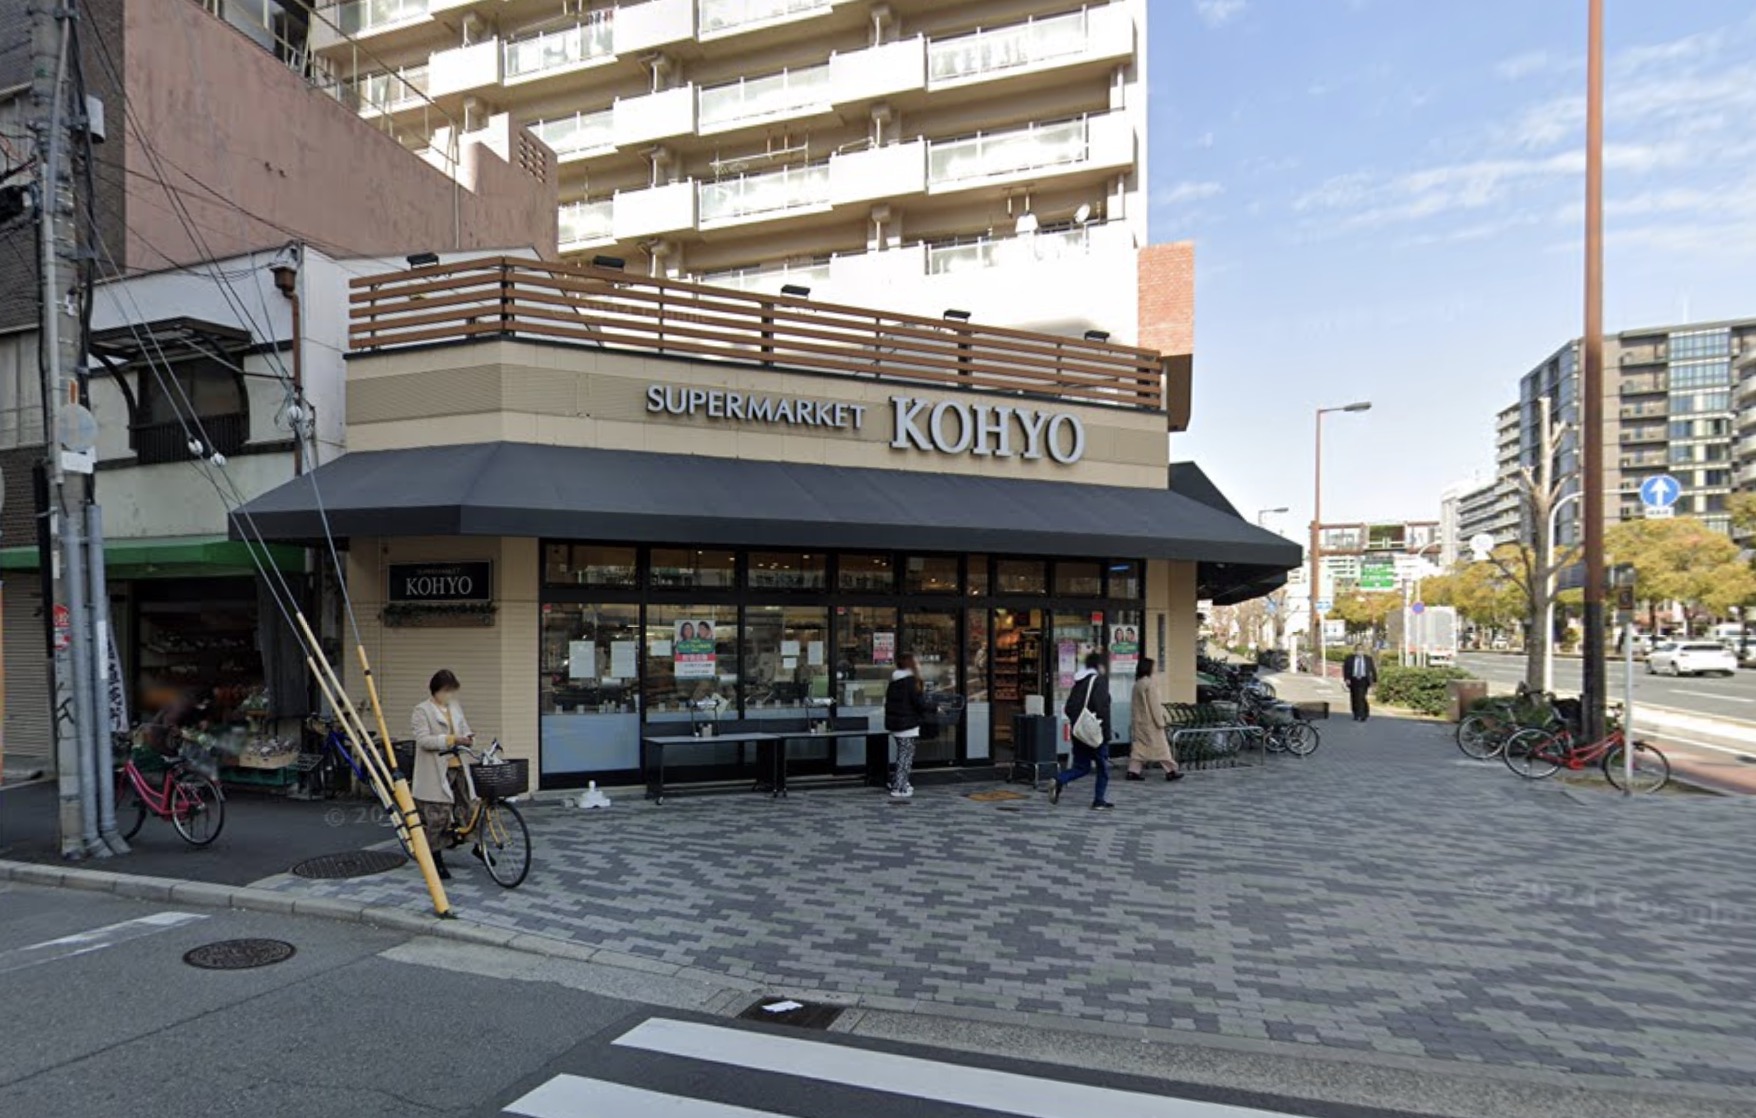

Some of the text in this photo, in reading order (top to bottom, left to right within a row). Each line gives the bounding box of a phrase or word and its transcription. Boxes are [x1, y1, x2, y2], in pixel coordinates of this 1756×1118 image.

[645, 384, 1086, 466] SUPERMARKET KOHYO
[405, 575, 473, 596] KOHYO
